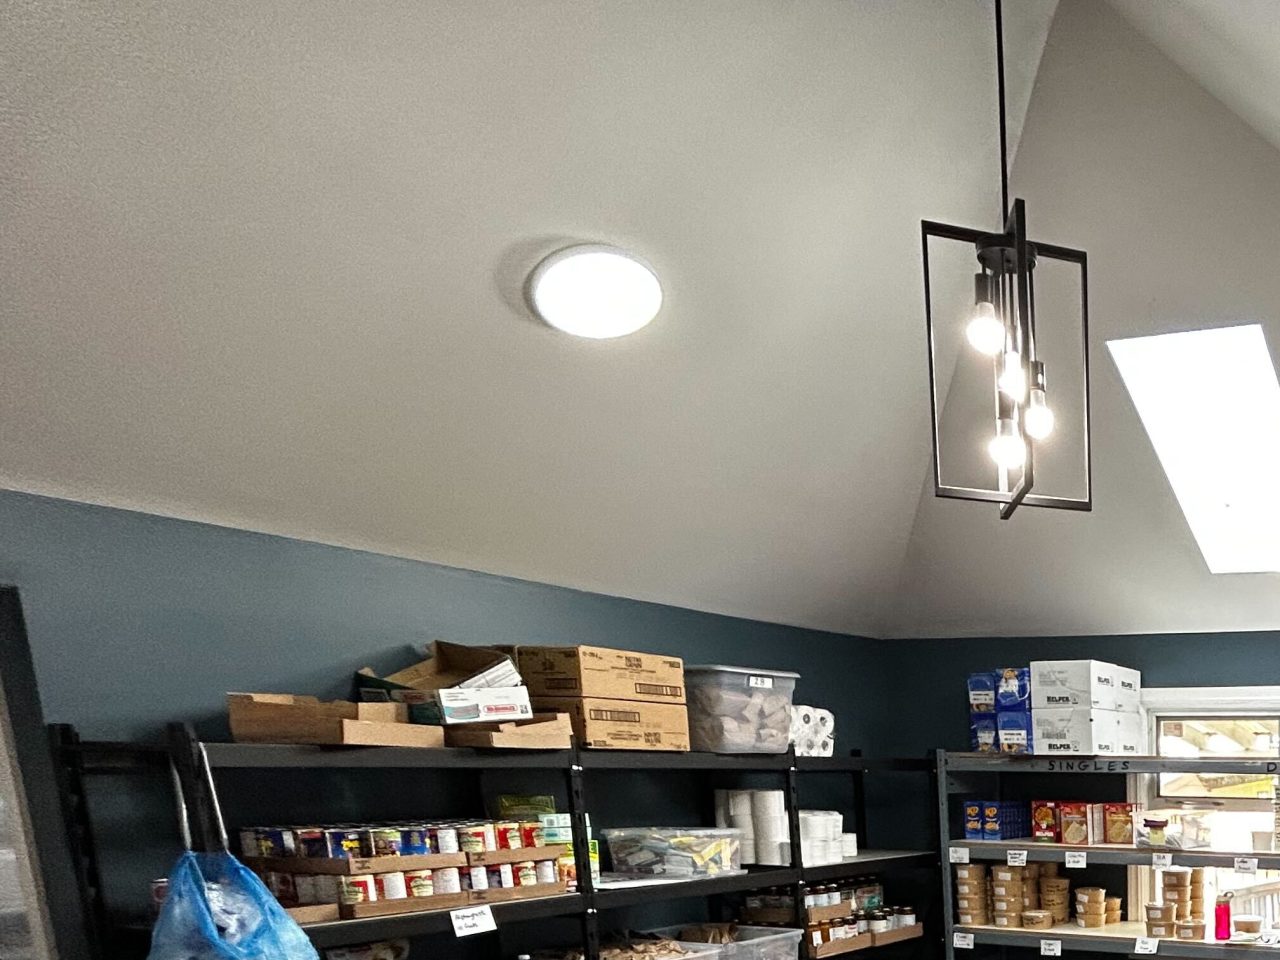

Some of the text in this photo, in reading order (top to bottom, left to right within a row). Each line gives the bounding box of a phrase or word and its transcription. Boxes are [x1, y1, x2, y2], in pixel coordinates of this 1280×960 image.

[1047, 696, 1070, 704] HELPER
[1048, 743, 1071, 751] HELPER
[1048, 761, 1130, 771] SINGLES
